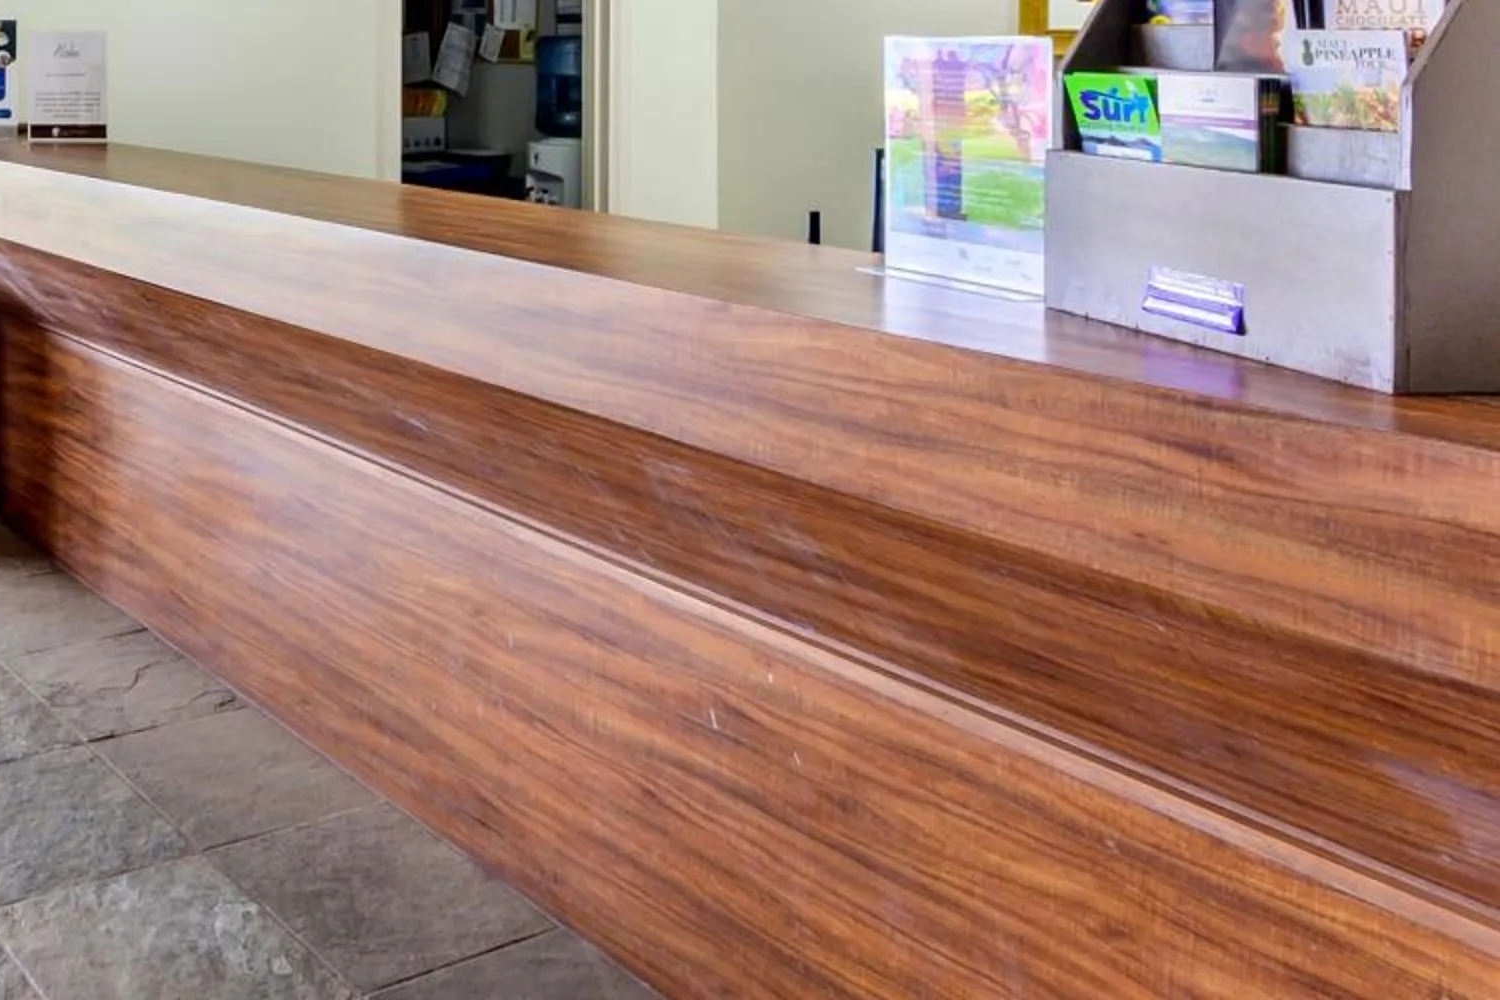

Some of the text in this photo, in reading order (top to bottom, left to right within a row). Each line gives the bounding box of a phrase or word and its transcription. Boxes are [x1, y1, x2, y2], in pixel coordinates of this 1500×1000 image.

[1336, 16, 1427, 27] CHOCOLATE
[1315, 48, 1397, 61] PINEAPPLE
[1079, 87, 1150, 123] Surf
